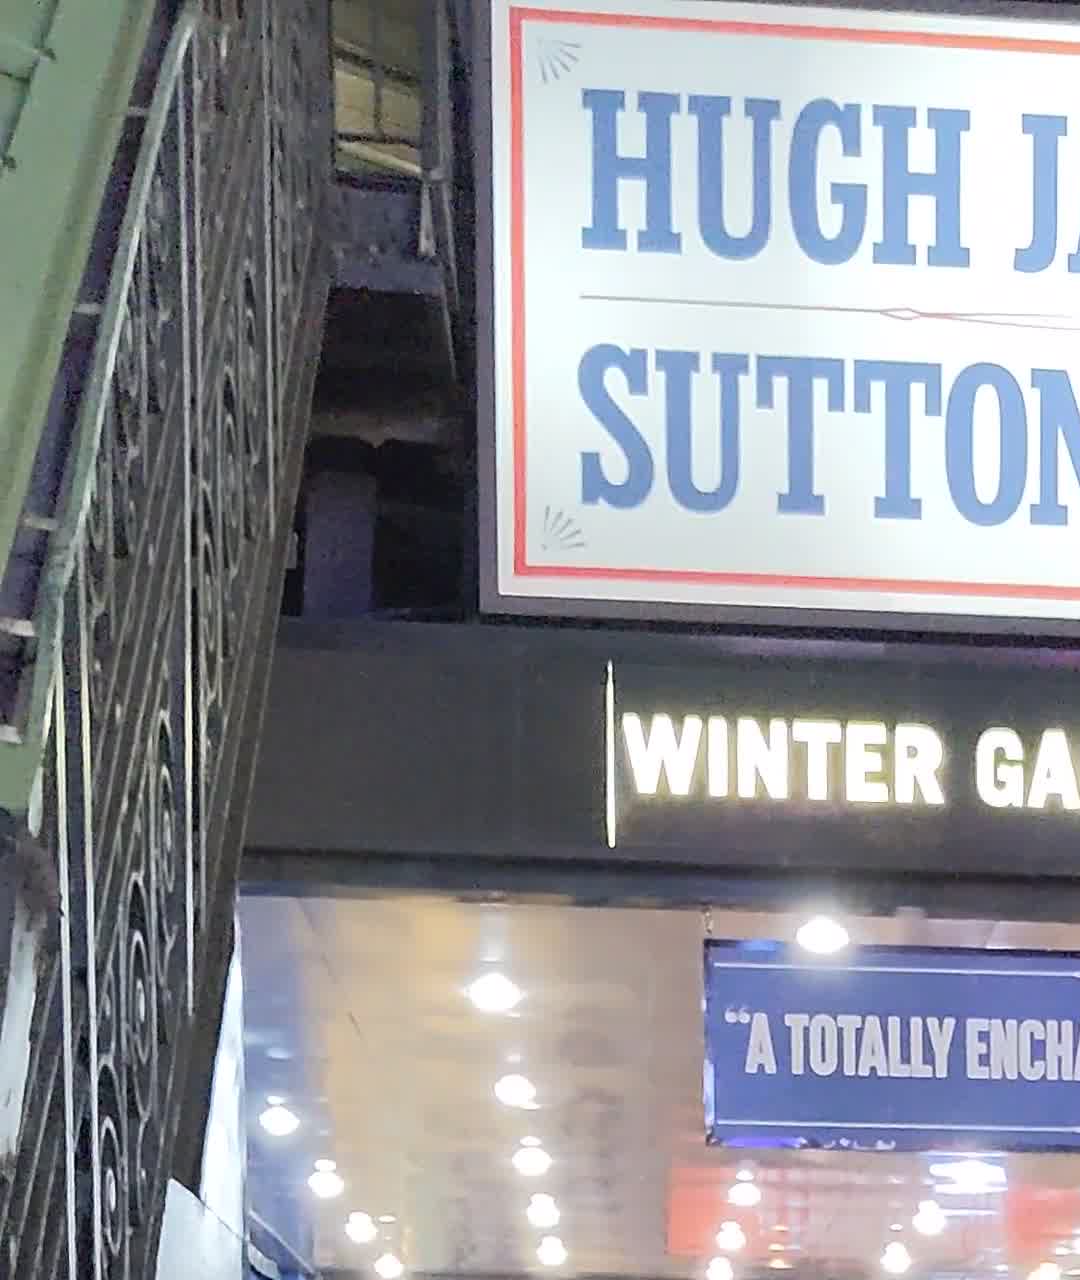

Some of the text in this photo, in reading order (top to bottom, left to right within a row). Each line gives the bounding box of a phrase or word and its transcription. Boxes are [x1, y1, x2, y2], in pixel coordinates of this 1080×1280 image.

[580, 87, 971, 268] HUGH
[622, 711, 945, 807] WINTER
[784, 1013, 957, 1081] TOTALLY
